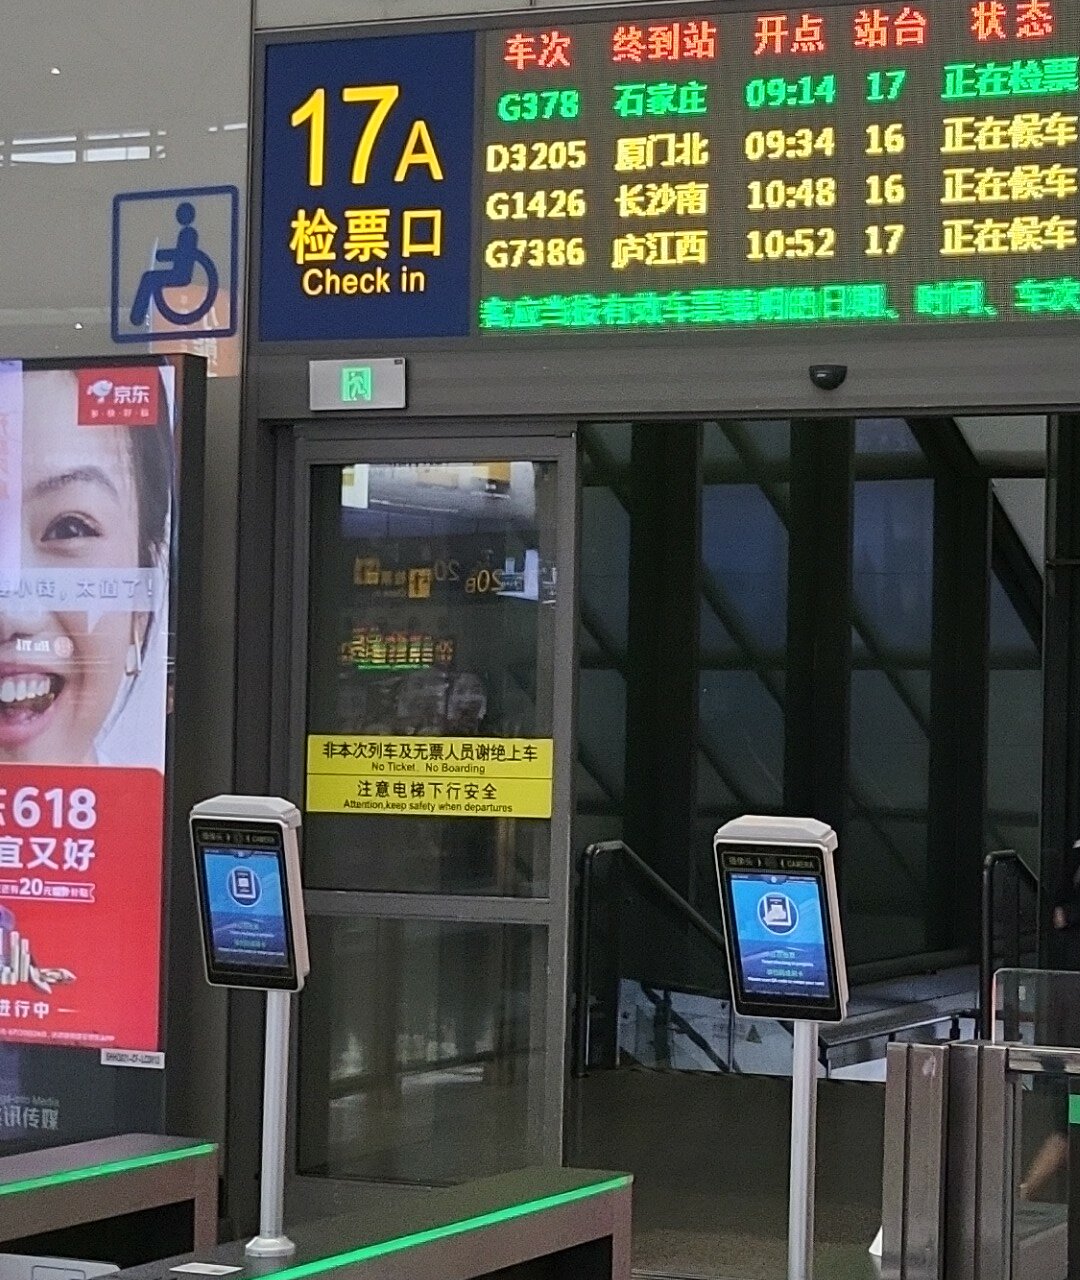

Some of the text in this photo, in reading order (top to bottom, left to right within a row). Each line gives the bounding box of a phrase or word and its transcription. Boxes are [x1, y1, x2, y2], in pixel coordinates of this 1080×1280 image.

[504, 32, 572, 70] 车次
[612, 21, 717, 64] 终到站
[754, 14, 825, 55] 开点
[853, 7, 927, 48] 站台
[498, 89, 579, 122] G378
[613, 81, 708, 117] 石家庄
[745, 74, 836, 109] 09:14
[866, 70, 906, 102] 17
[940, 56, 1079, 100] 正在检票
[290, 85, 443, 186] 17A
[486, 139, 587, 173] D3205
[613, 132, 709, 171] 厦门北
[745, 127, 835, 161] 09:34
[865, 124, 905, 156] 16
[940, 111, 1079, 155] 正在候车
[486, 189, 586, 221] G1426
[614, 181, 709, 218] 长沙南
[746, 178, 836, 212] 10:48
[865, 174, 905, 206] 16
[940, 163, 1079, 207] 正在候车
[290, 208, 442, 265] 检票口
[485, 237, 585, 271] G7386
[612, 230, 708, 269] 庐江西
[746, 228, 835, 261] 10:52
[865, 224, 904, 255] 17
[939, 216, 1078, 255] 正在候车
[303, 265, 426, 296] Check in
[114, 385, 150, 404] 京东
[322, 741, 538, 763] 非本次列车及无票人员谢绝上车
[371, 762, 486, 775] No Ticket No Boarding
[357, 780, 498, 801] 注意电梯下行安全
[409, 801, 436, 812] safety
[438, 802, 462, 811] when
[464, 803, 513, 813] departures
